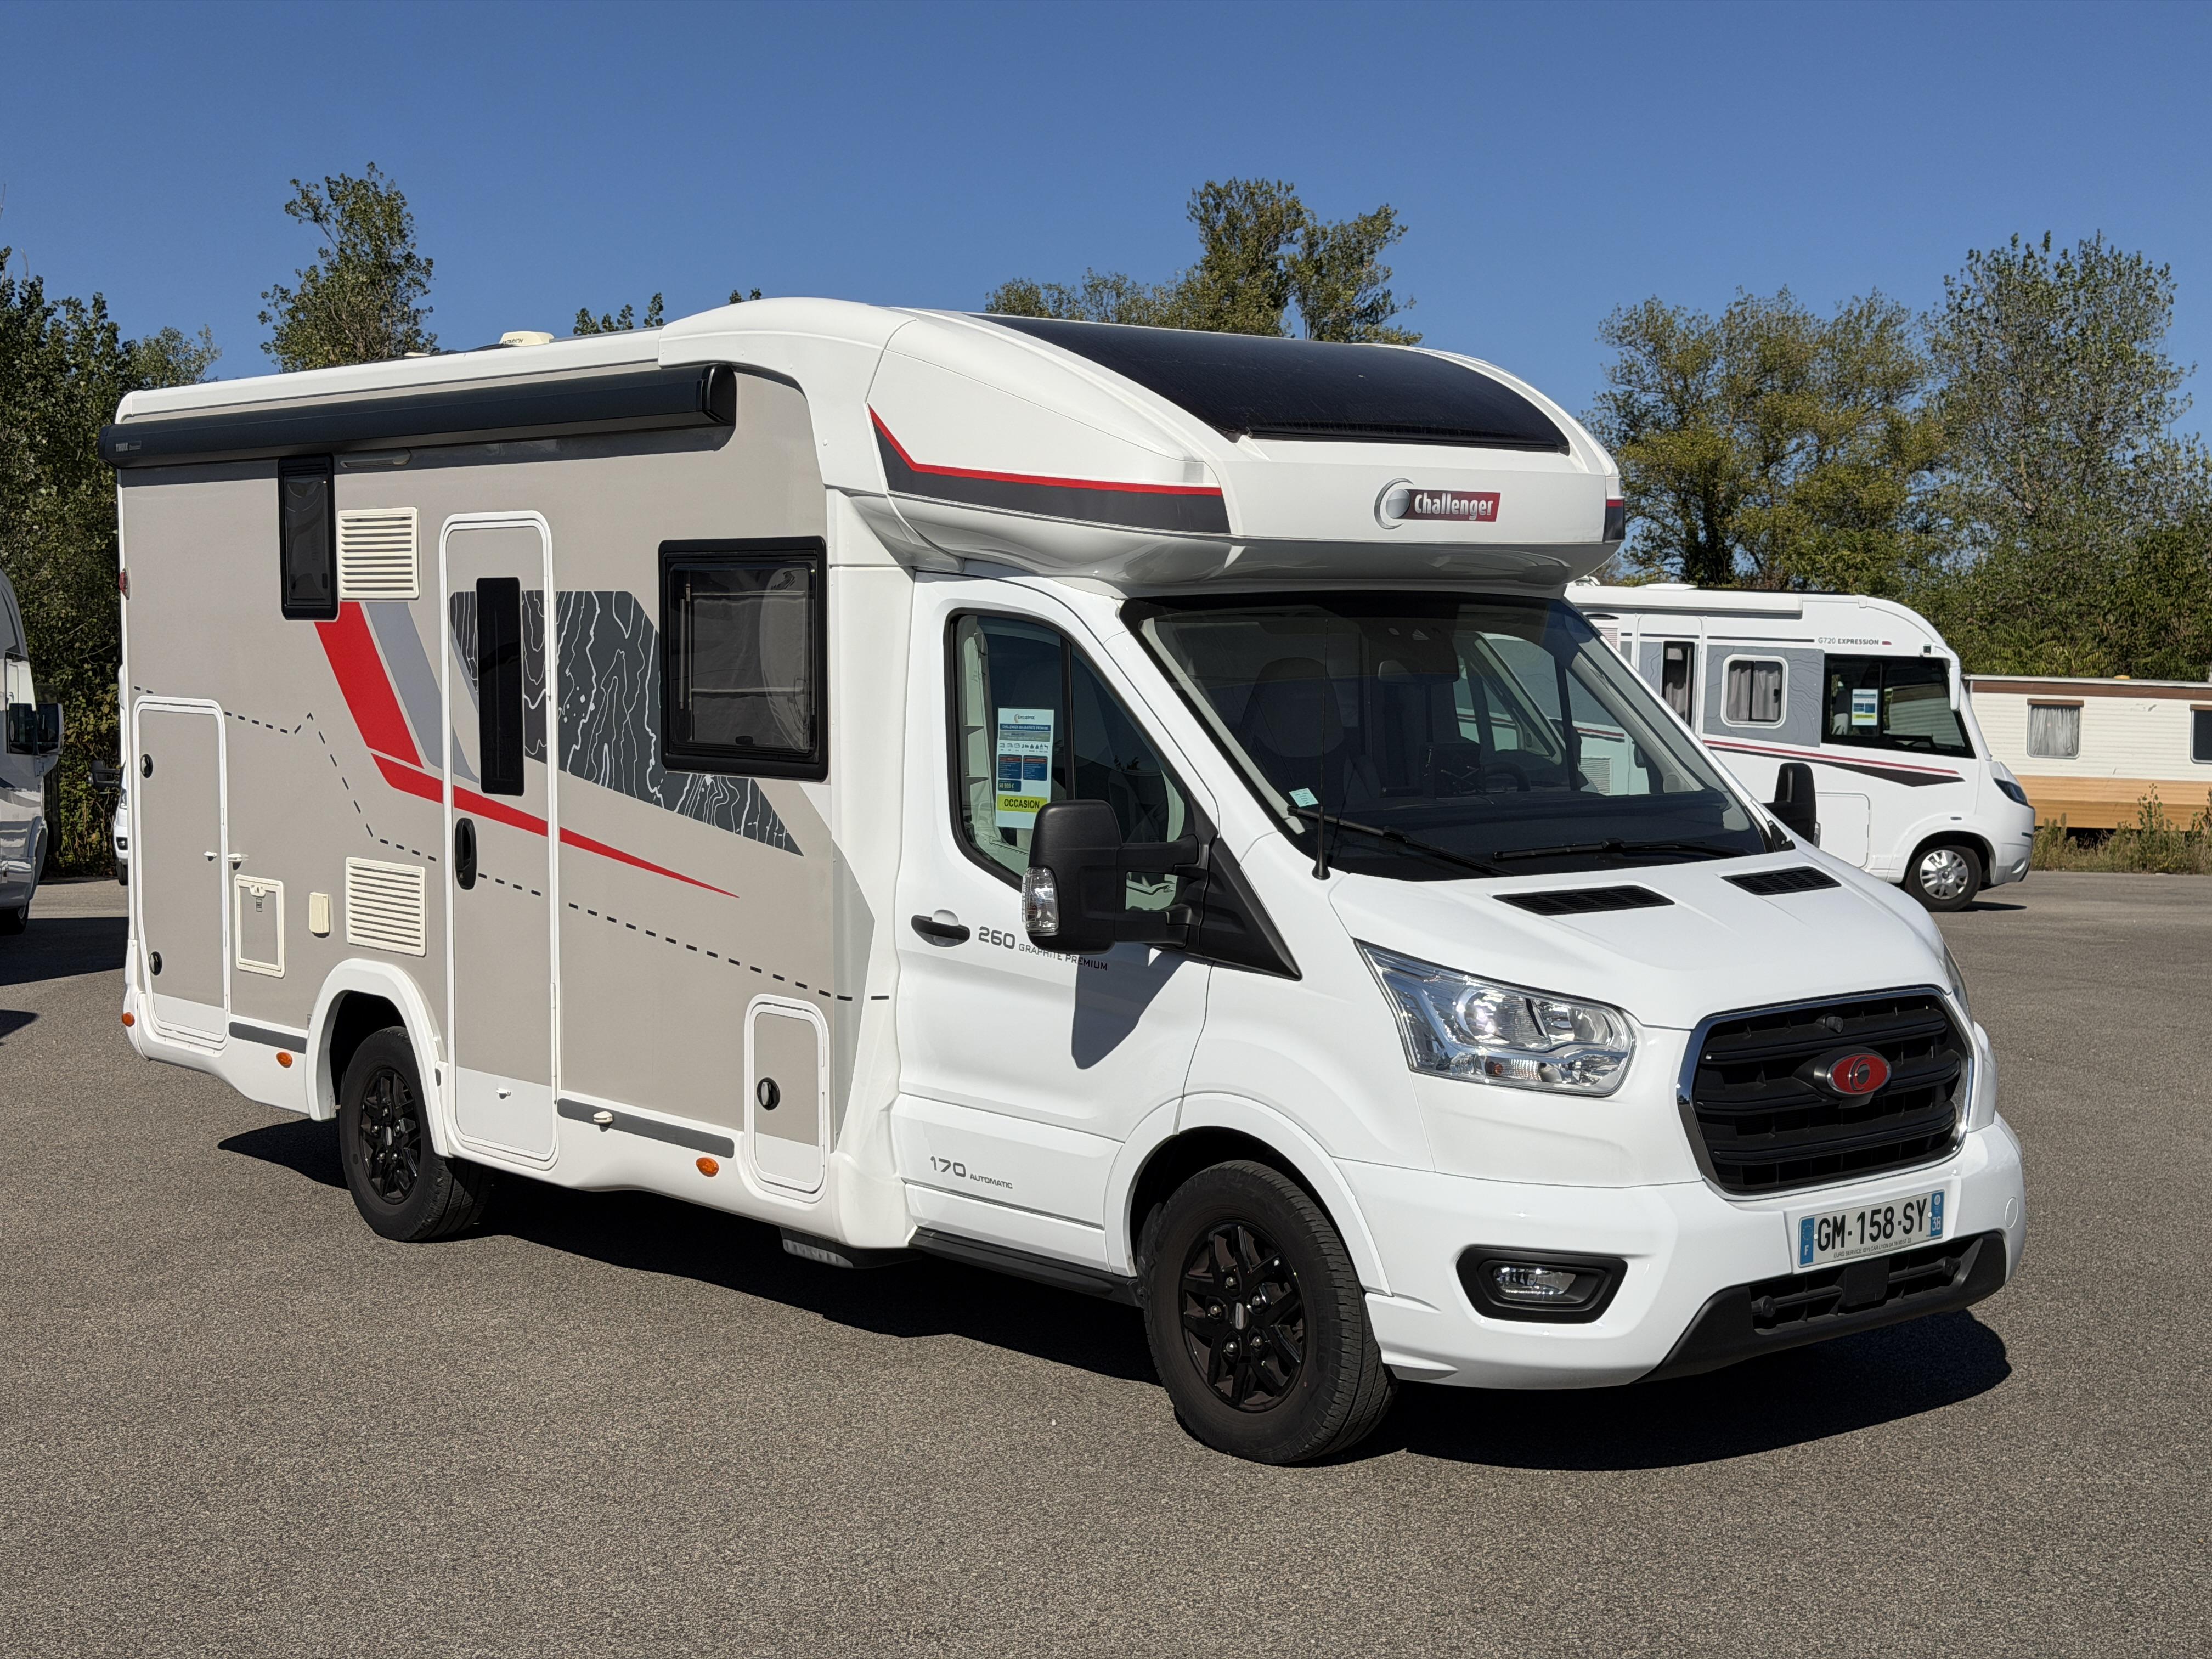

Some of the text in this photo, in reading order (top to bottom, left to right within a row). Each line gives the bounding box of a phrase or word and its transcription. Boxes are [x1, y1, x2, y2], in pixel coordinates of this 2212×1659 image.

[1414, 492, 1494, 521] Challenger
[1003, 798, 1040, 809] OCCASION
[978, 926, 1016, 950] 260
[1065, 953, 1108, 972] PREMIUM
[930, 1155, 1014, 1189] 170 AUTOMATIC
[1817, 1198, 1927, 1251] GM-158-SY
[1932, 1216, 1941, 1231] 38
[1804, 1245, 1809, 1256] F
[1846, 1248, 1862, 1256] SERVICE
